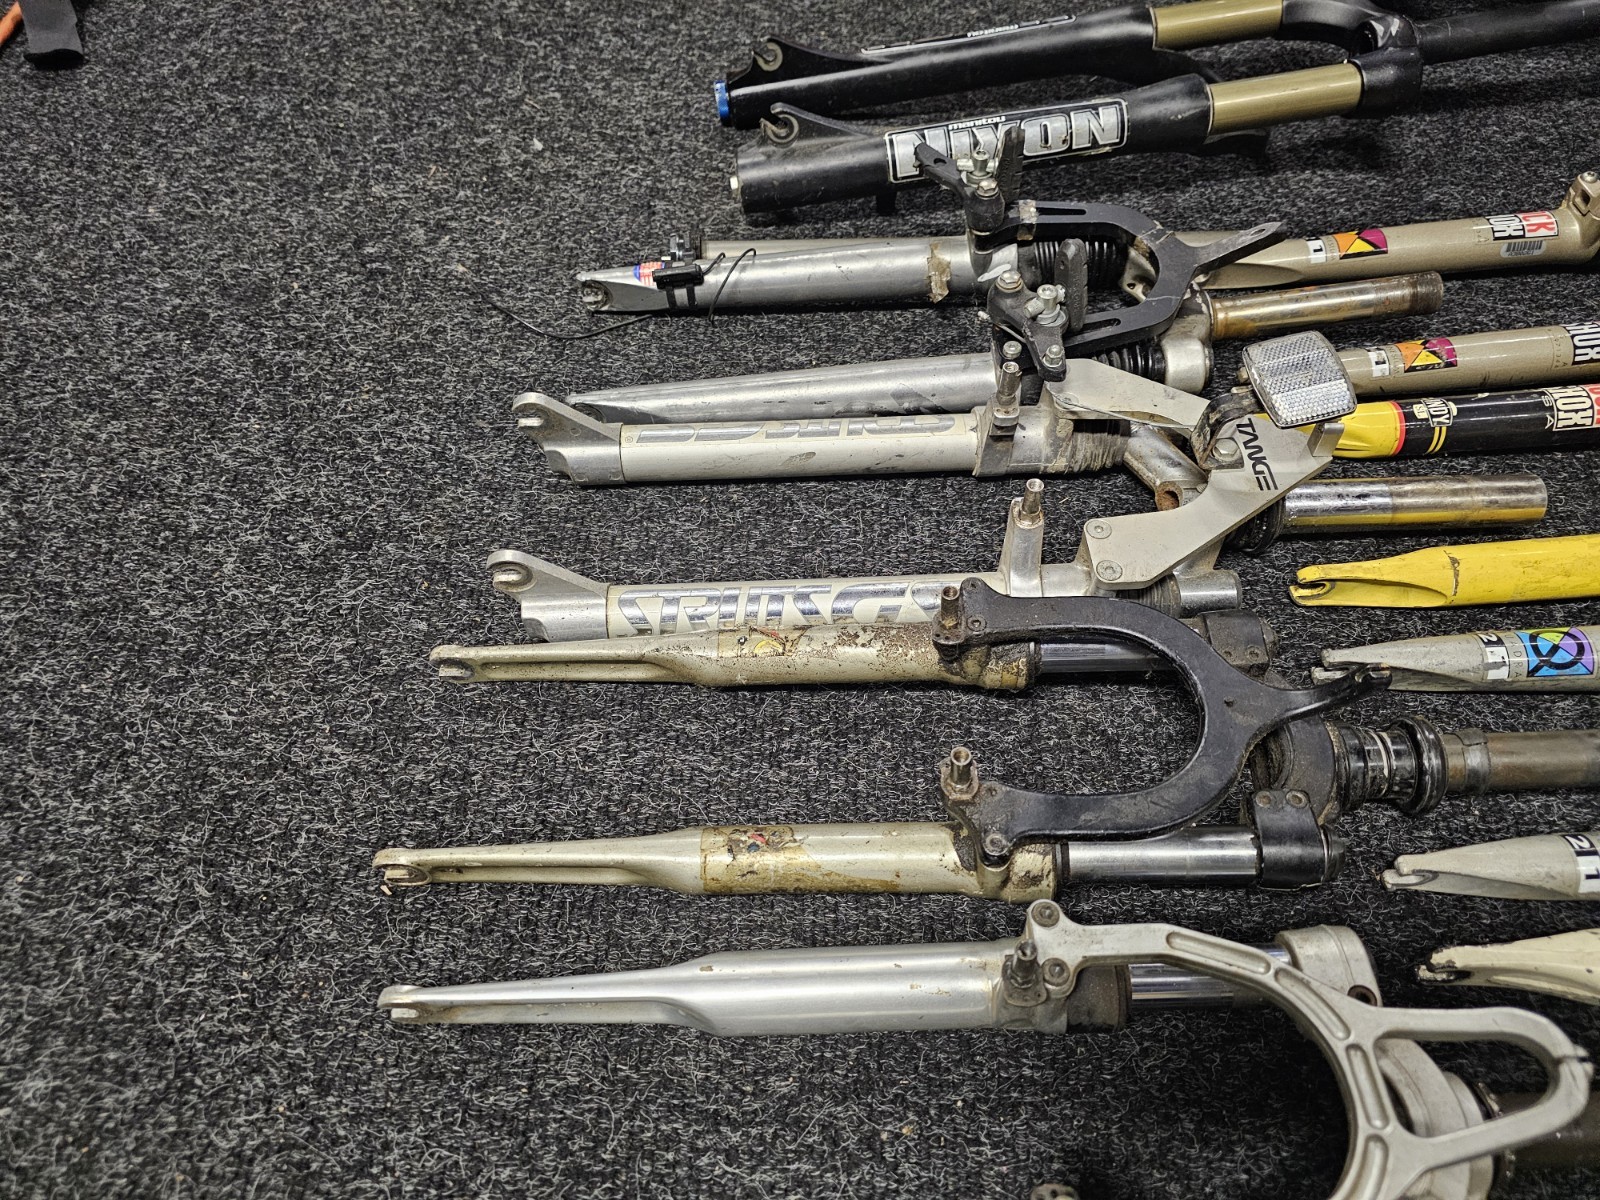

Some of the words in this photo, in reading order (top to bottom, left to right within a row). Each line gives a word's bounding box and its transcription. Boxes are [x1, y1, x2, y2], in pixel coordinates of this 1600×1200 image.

[948, 115, 1006, 130] manitou
[1562, 322, 1600, 362] HOX
[1547, 386, 1593, 428] HOX
[1235, 417, 1279, 492] TANGE
